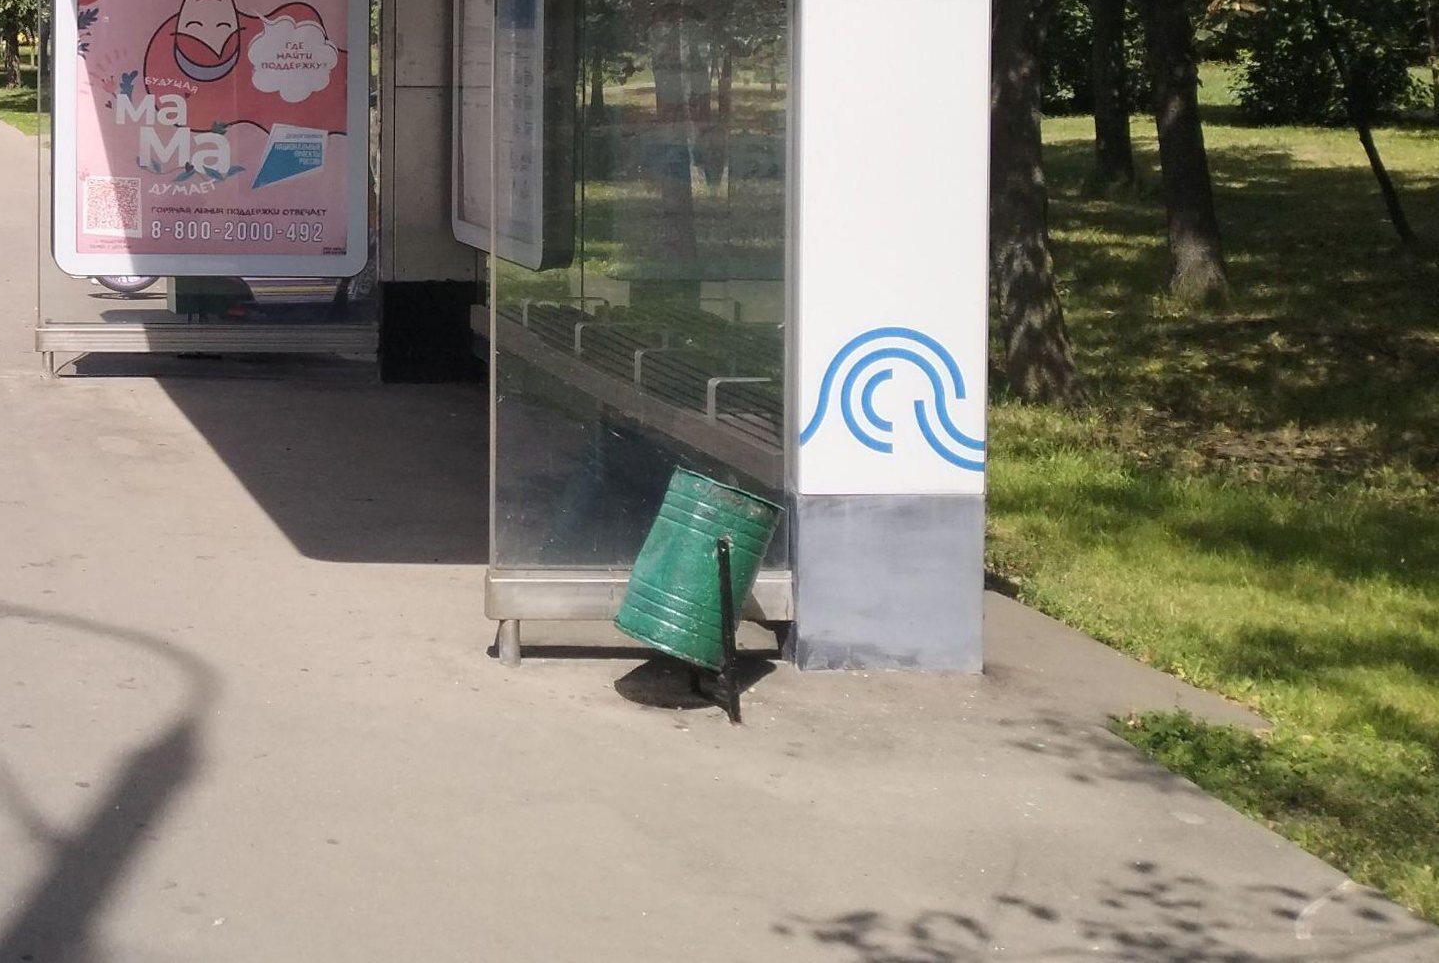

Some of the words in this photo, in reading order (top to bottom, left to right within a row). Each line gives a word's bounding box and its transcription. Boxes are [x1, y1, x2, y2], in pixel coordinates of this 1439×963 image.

[285, 41, 305, 50] ГДЕ
[276, 52, 313, 60] НАЙТИ
[144, 76, 199, 95] БУДУЩАЯ
[148, 179, 216, 196] ДУМАЕТ
[151, 220, 324, 243] 8-800-2000-492
